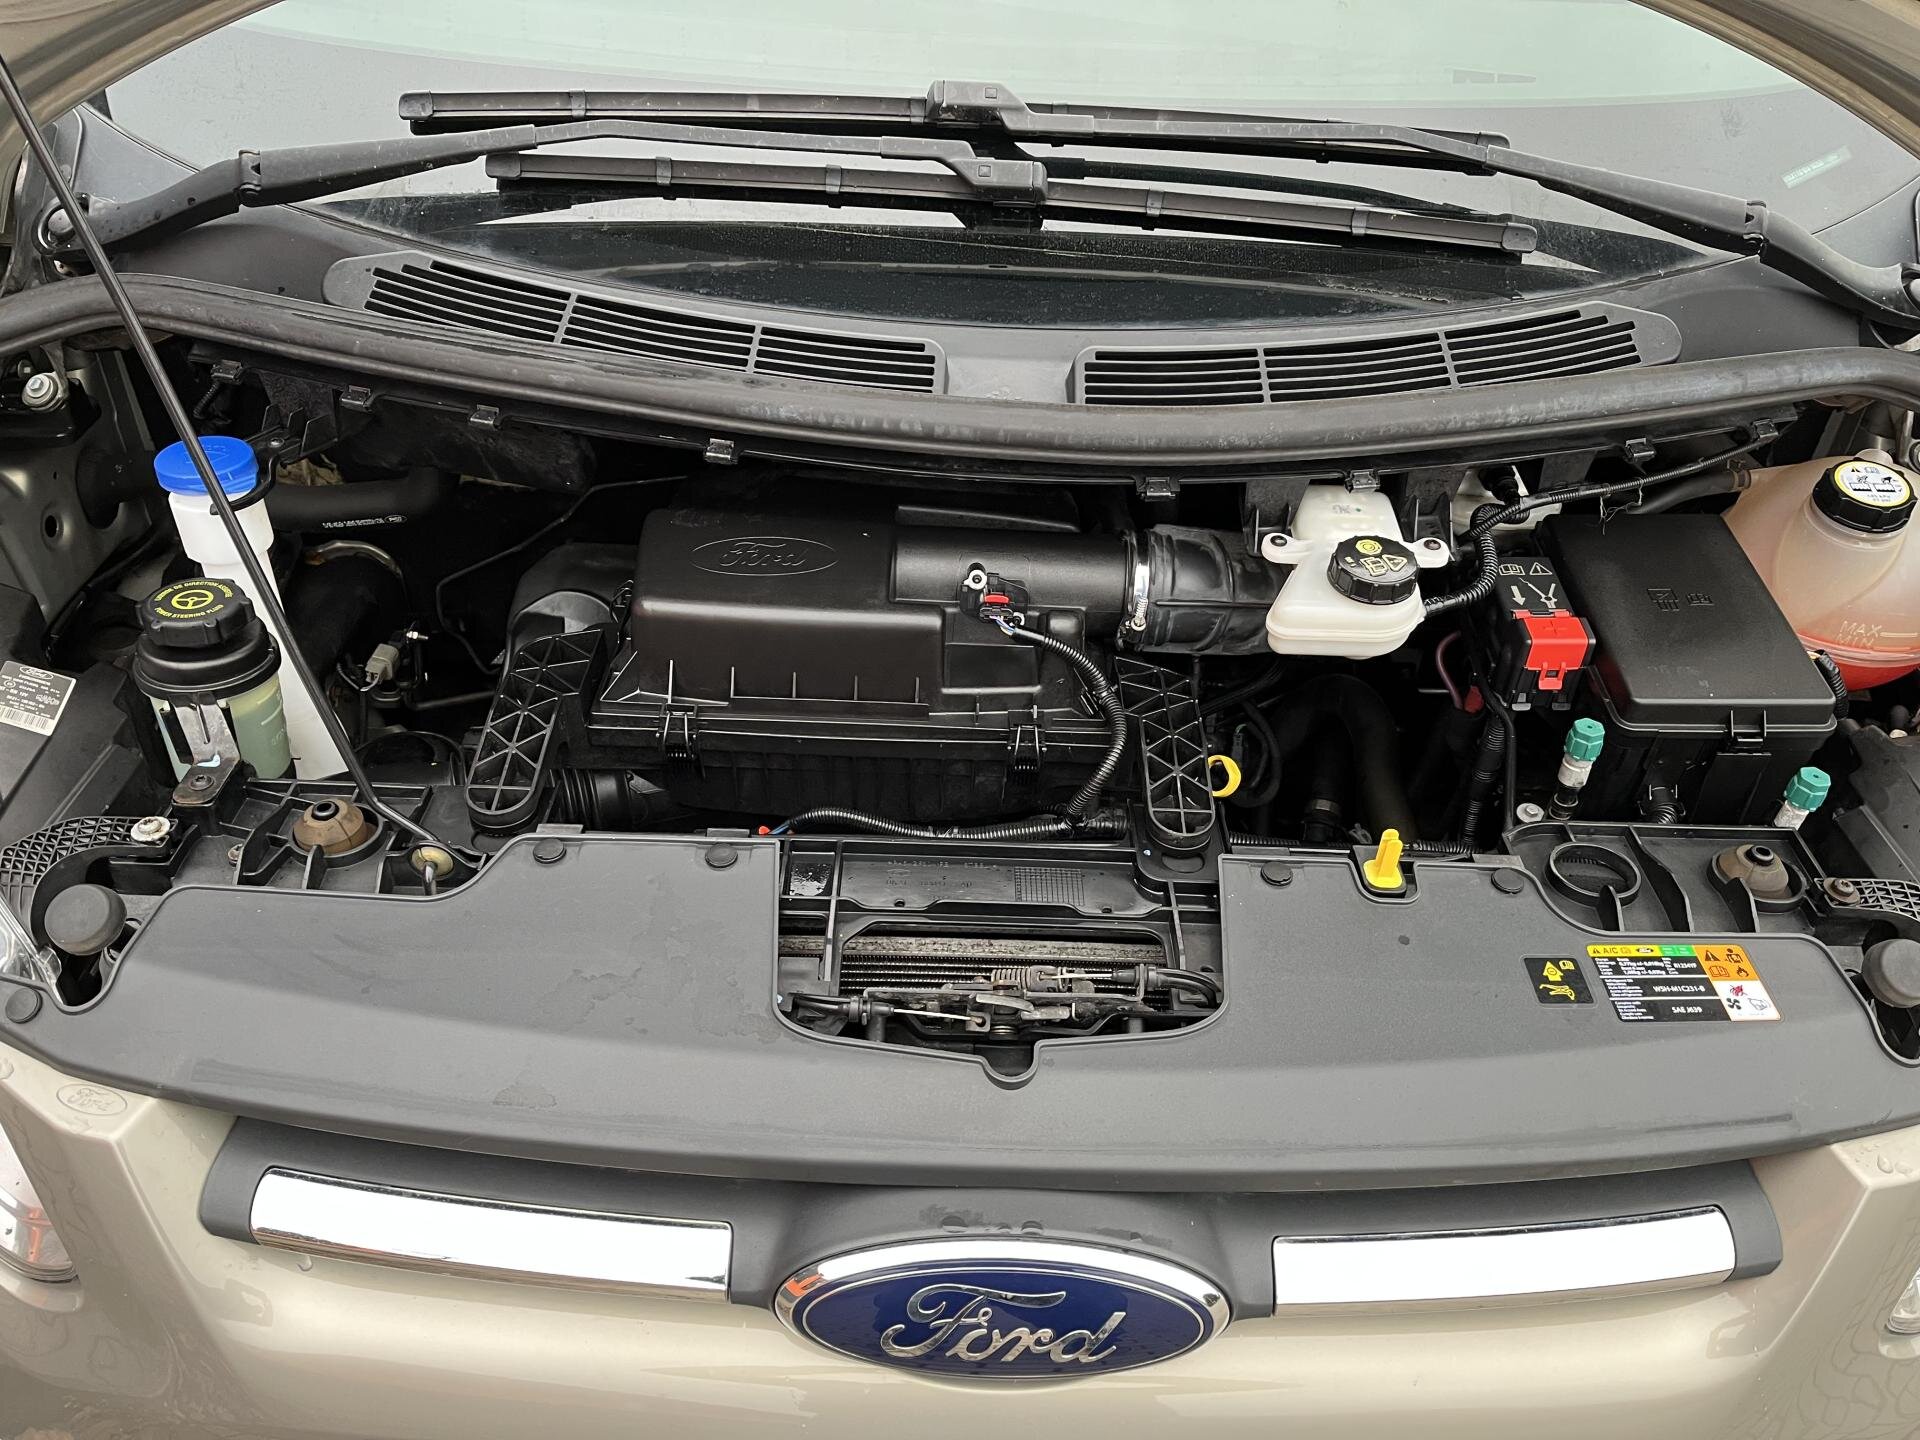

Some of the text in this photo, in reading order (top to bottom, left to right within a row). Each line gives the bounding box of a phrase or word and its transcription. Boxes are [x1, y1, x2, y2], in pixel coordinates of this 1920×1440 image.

[719, 541, 808, 566] Ford
[172, 611, 206, 619] STEERING
[1839, 620, 1882, 638] MAX
[1671, 1006, 1686, 1014] SAE
[67, 1088, 116, 1112] Ford
[880, 1283, 1127, 1364] Ford
